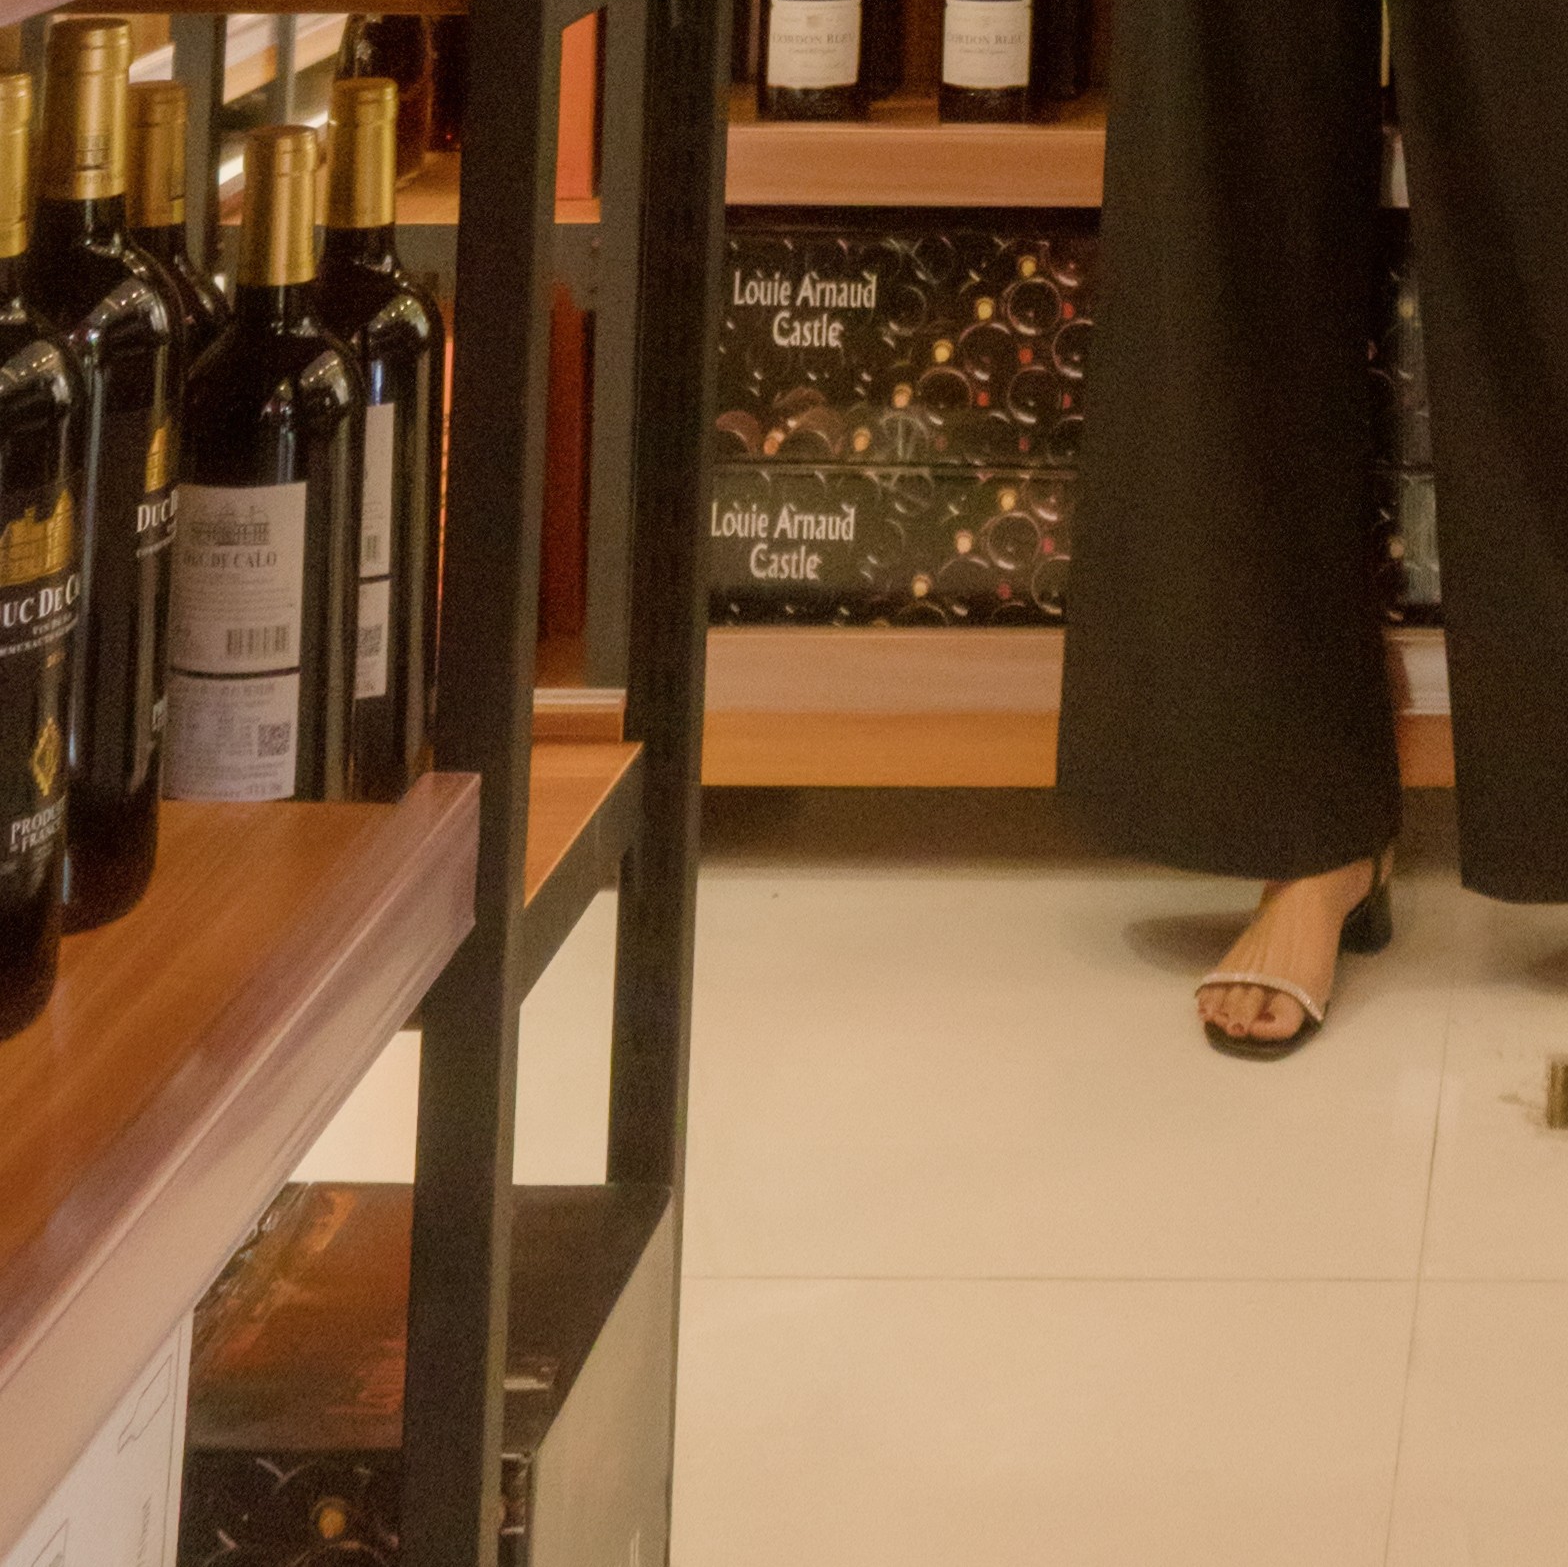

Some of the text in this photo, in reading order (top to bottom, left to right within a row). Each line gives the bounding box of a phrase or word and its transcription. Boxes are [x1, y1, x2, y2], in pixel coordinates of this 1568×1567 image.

[733, 269, 877, 308] Louie Arnaud
[772, 311, 844, 348] Castle
[710, 502, 855, 541] Louie Arnaud
[749, 543, 821, 581] Castle
[39, 587, 64, 618] DE
